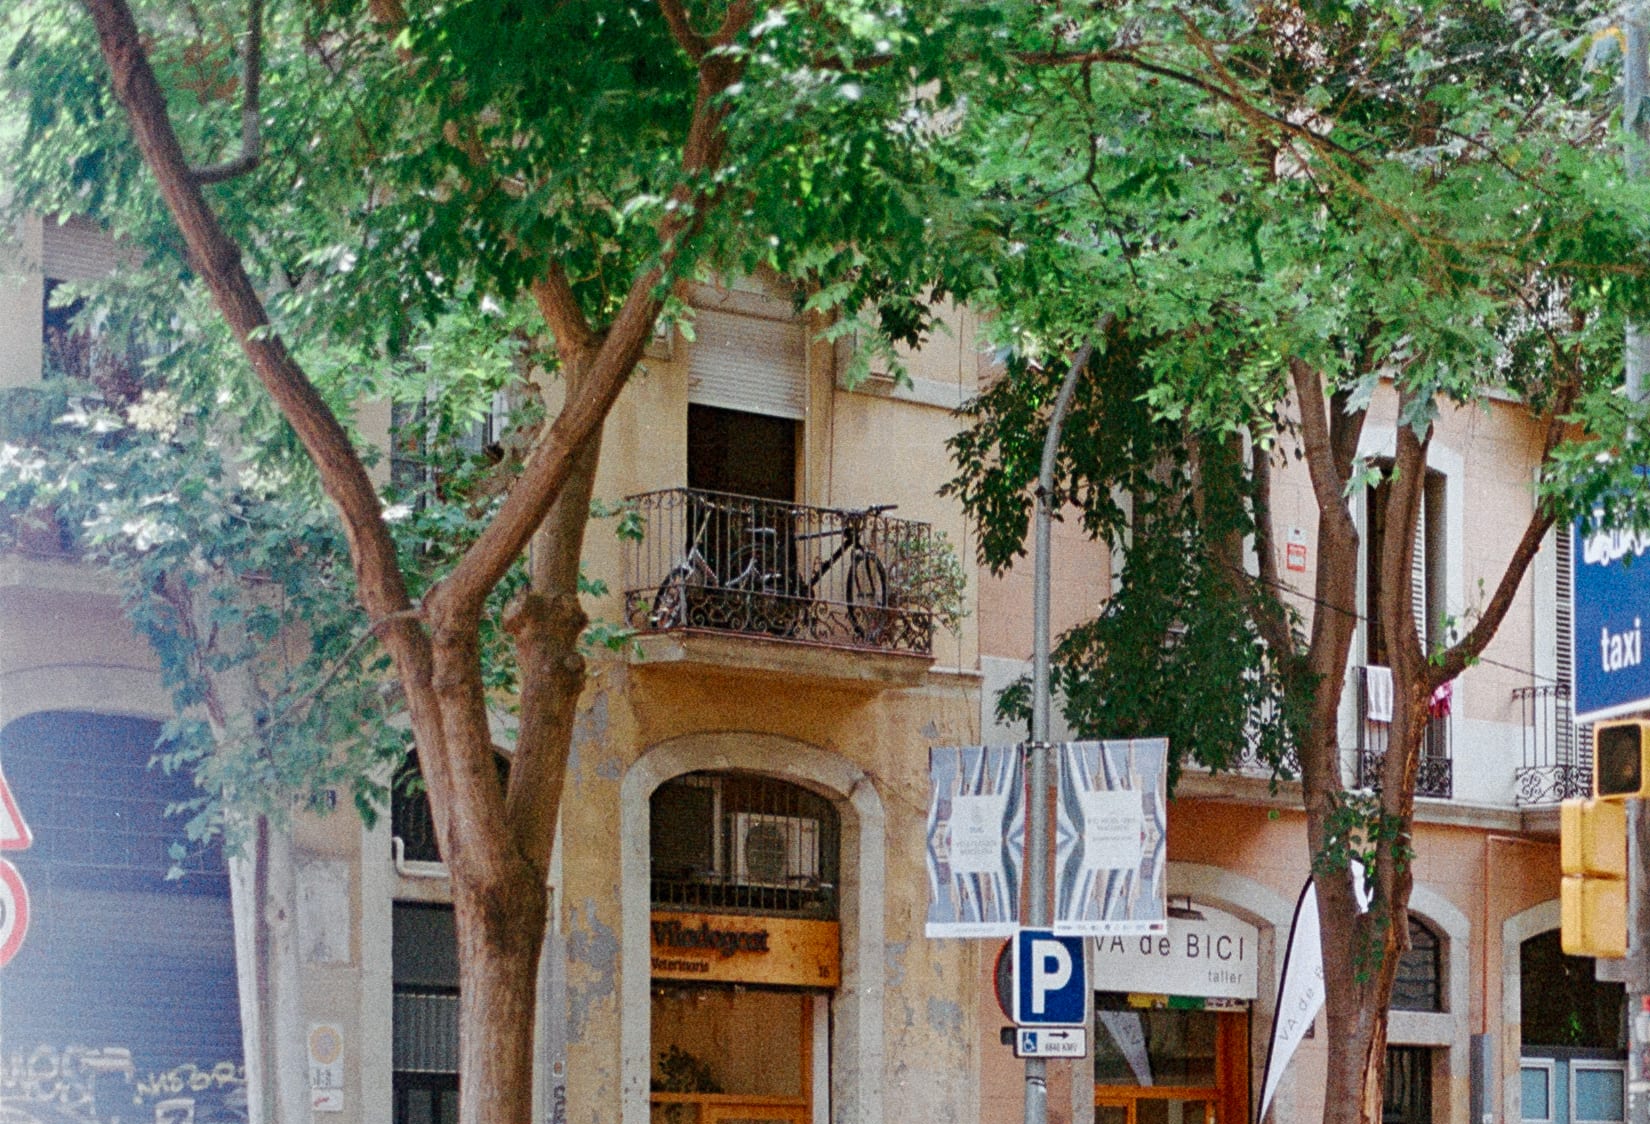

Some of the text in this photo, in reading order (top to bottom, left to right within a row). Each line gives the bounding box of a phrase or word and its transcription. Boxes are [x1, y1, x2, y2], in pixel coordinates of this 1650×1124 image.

[1601, 617, 1642, 672] taxi
[1139, 934, 1171, 957] de
[1187, 933, 1244, 961] BICI
[1031, 939, 1073, 1014] P
[1208, 969, 1243, 985] taller
